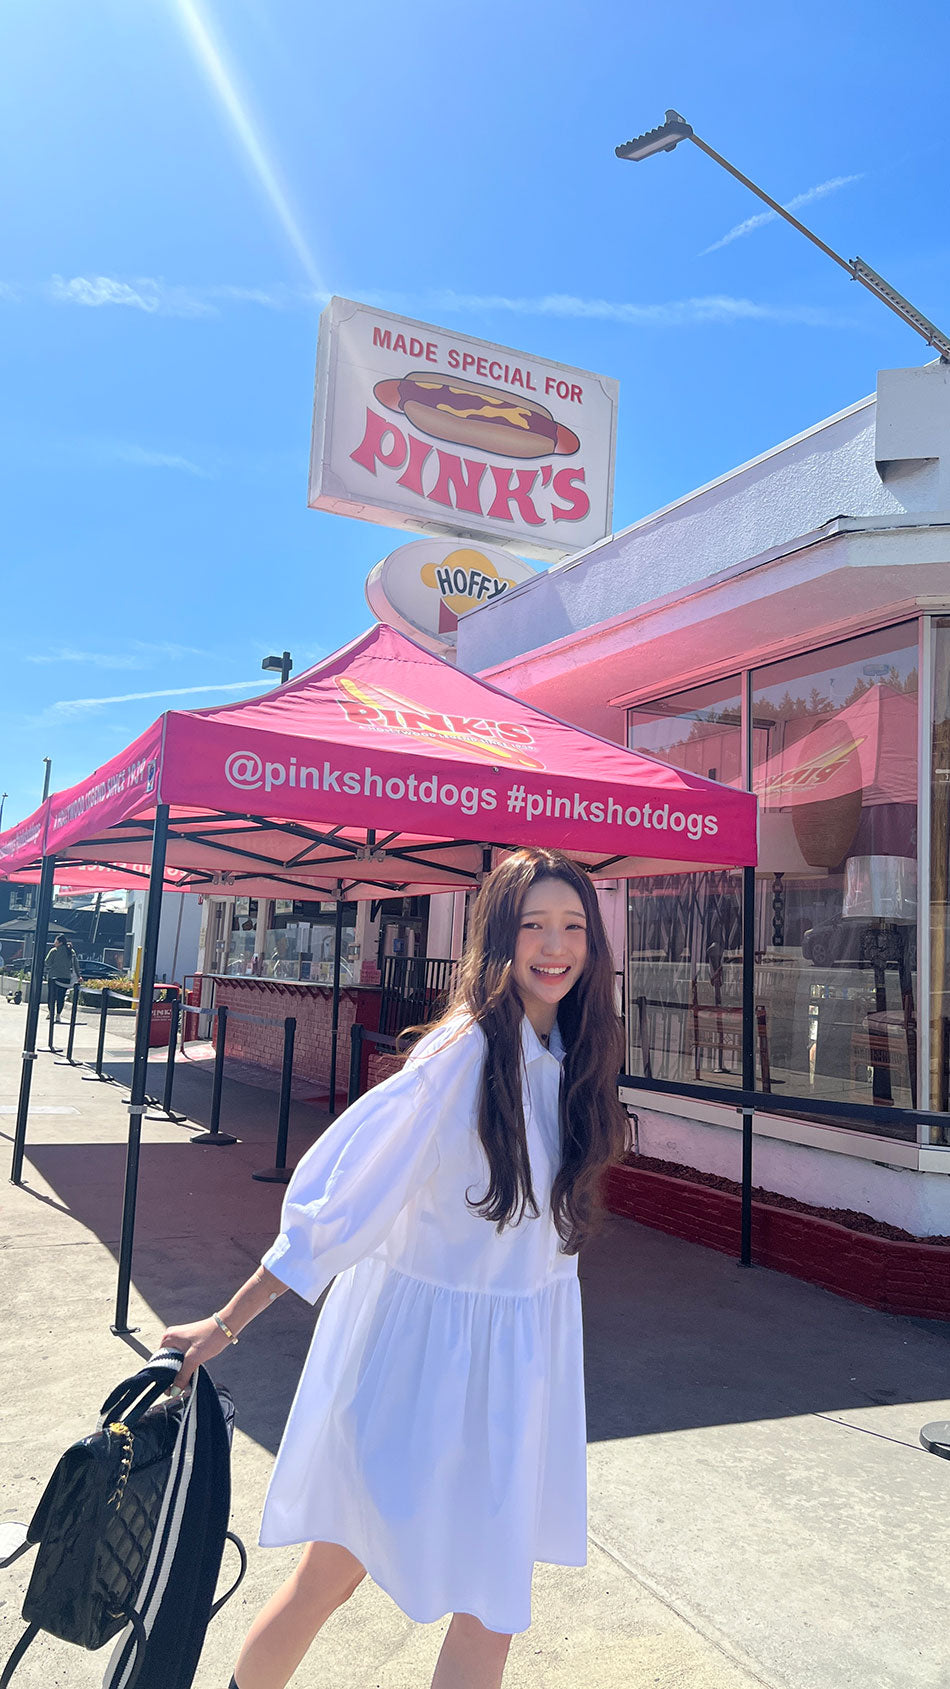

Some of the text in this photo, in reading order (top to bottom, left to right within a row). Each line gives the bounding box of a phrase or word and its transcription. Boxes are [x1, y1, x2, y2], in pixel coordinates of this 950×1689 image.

[373, 326, 584, 405] MADE SPECIAL FOR
[349, 406, 591, 526] PINK'S
[436, 567, 508, 600] HOFFY
[338, 699, 536, 745] PINK'S
[106, 769, 126, 799] SINCE
[224, 750, 719, 840] @pinkshotdogs #pinkshotdogs
